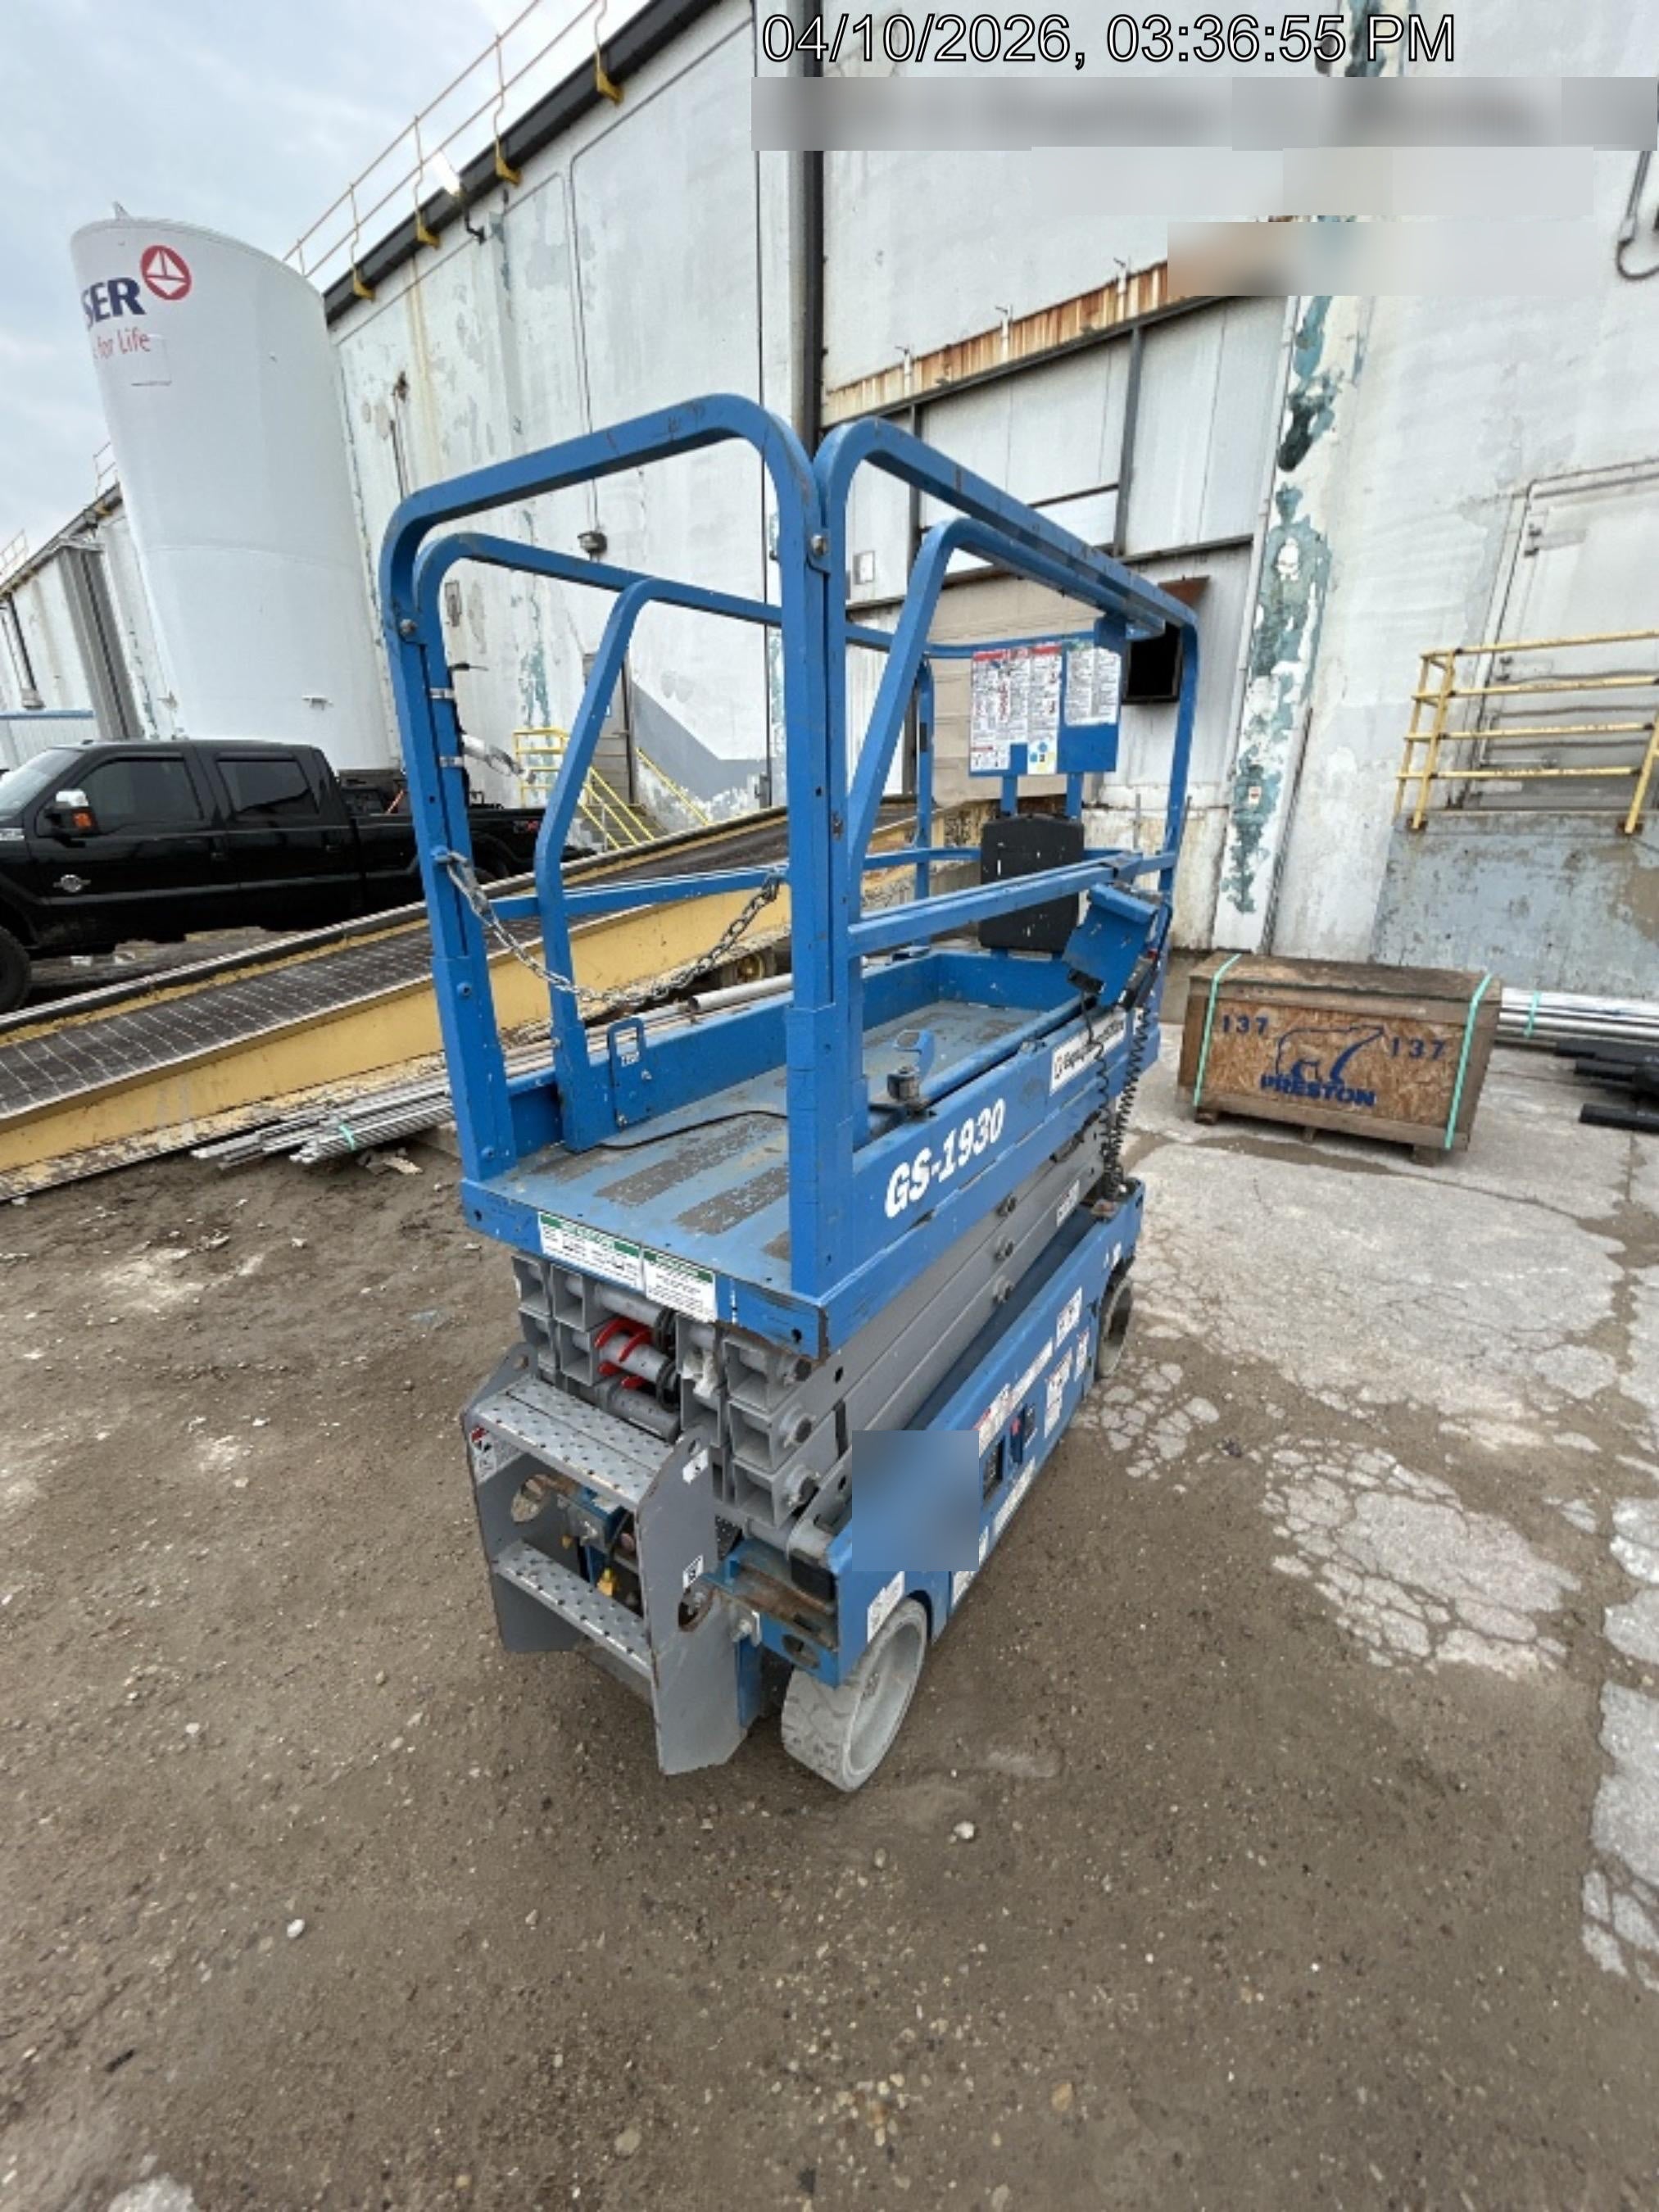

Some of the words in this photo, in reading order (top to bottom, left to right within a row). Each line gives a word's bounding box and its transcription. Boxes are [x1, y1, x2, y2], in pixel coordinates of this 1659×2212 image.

[1222, 1014, 1269, 1036] 137
[1392, 1036, 1446, 1060] 137
[1260, 1073, 1376, 1106] PRESTON
[884, 1098, 1006, 1219] GS-1930
